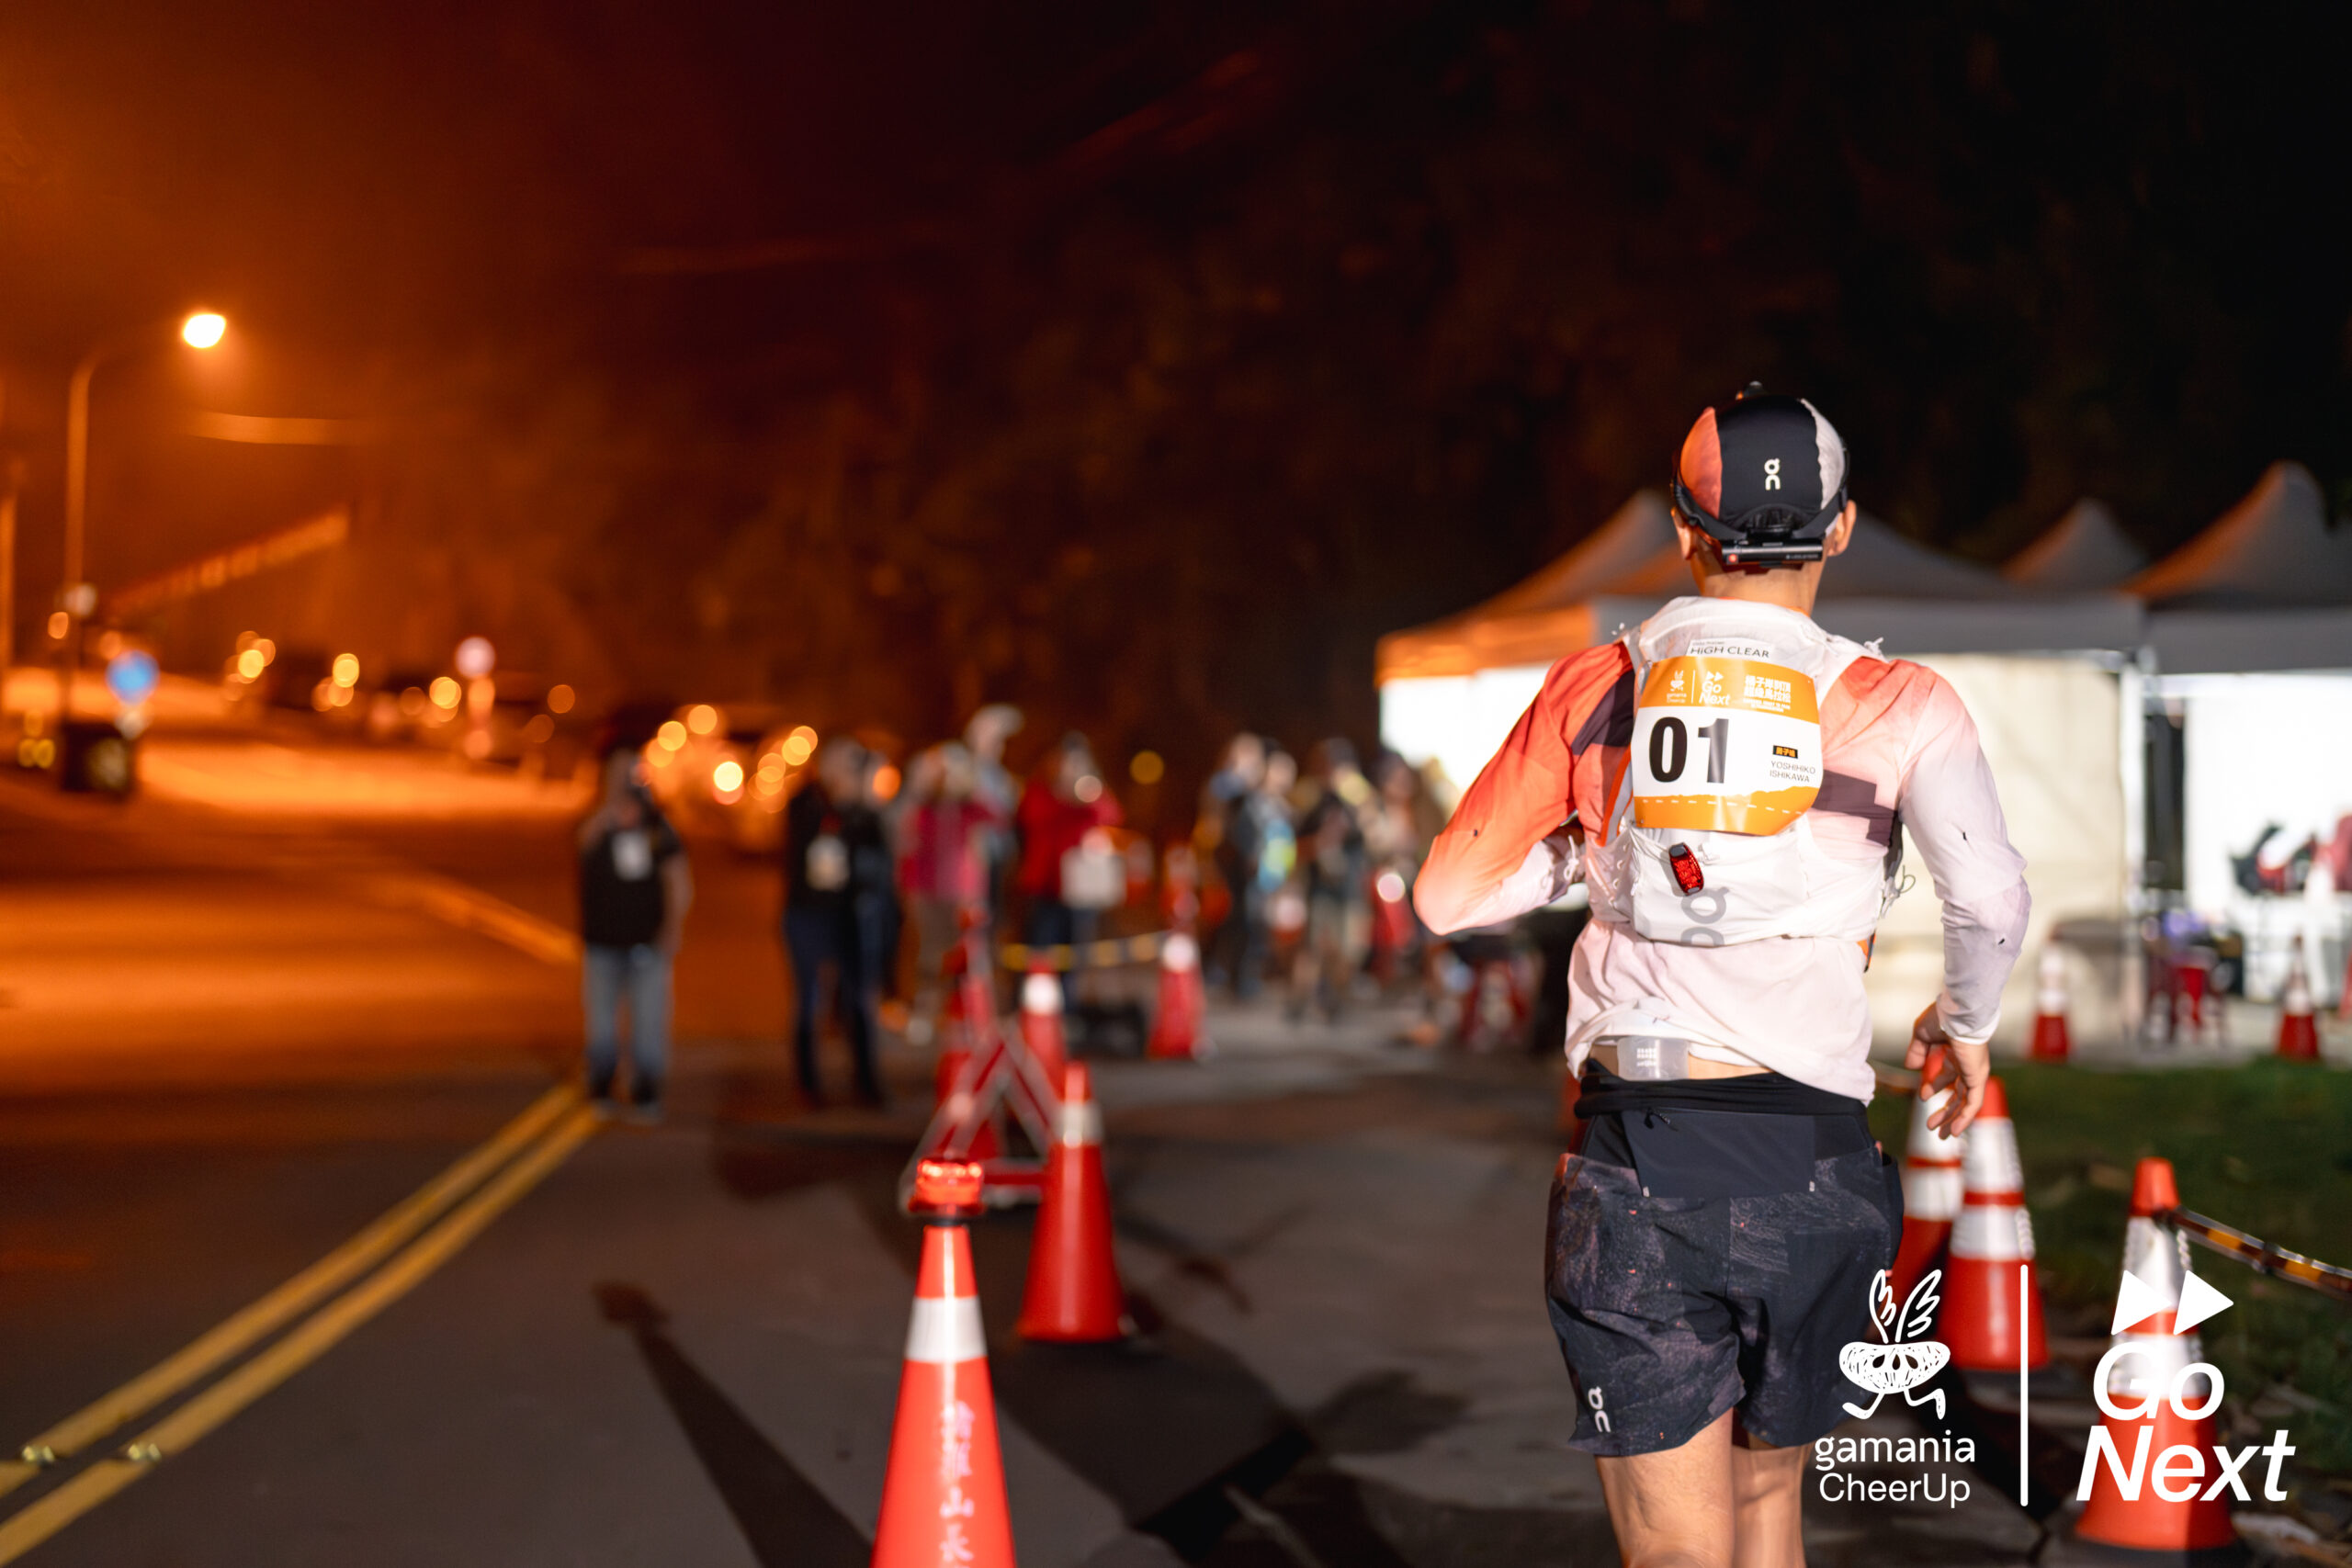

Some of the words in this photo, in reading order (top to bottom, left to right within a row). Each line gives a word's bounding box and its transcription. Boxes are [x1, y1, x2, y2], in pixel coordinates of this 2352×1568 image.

[1727, 646, 1770, 659] CLEAR
[1702, 680, 1722, 694] Go
[1699, 691, 1731, 705] Next
[1649, 716, 1730, 784] 01
[1770, 761, 1816, 774] YOSHIHIKO
[1770, 770, 1810, 783] ISHIKAWA
